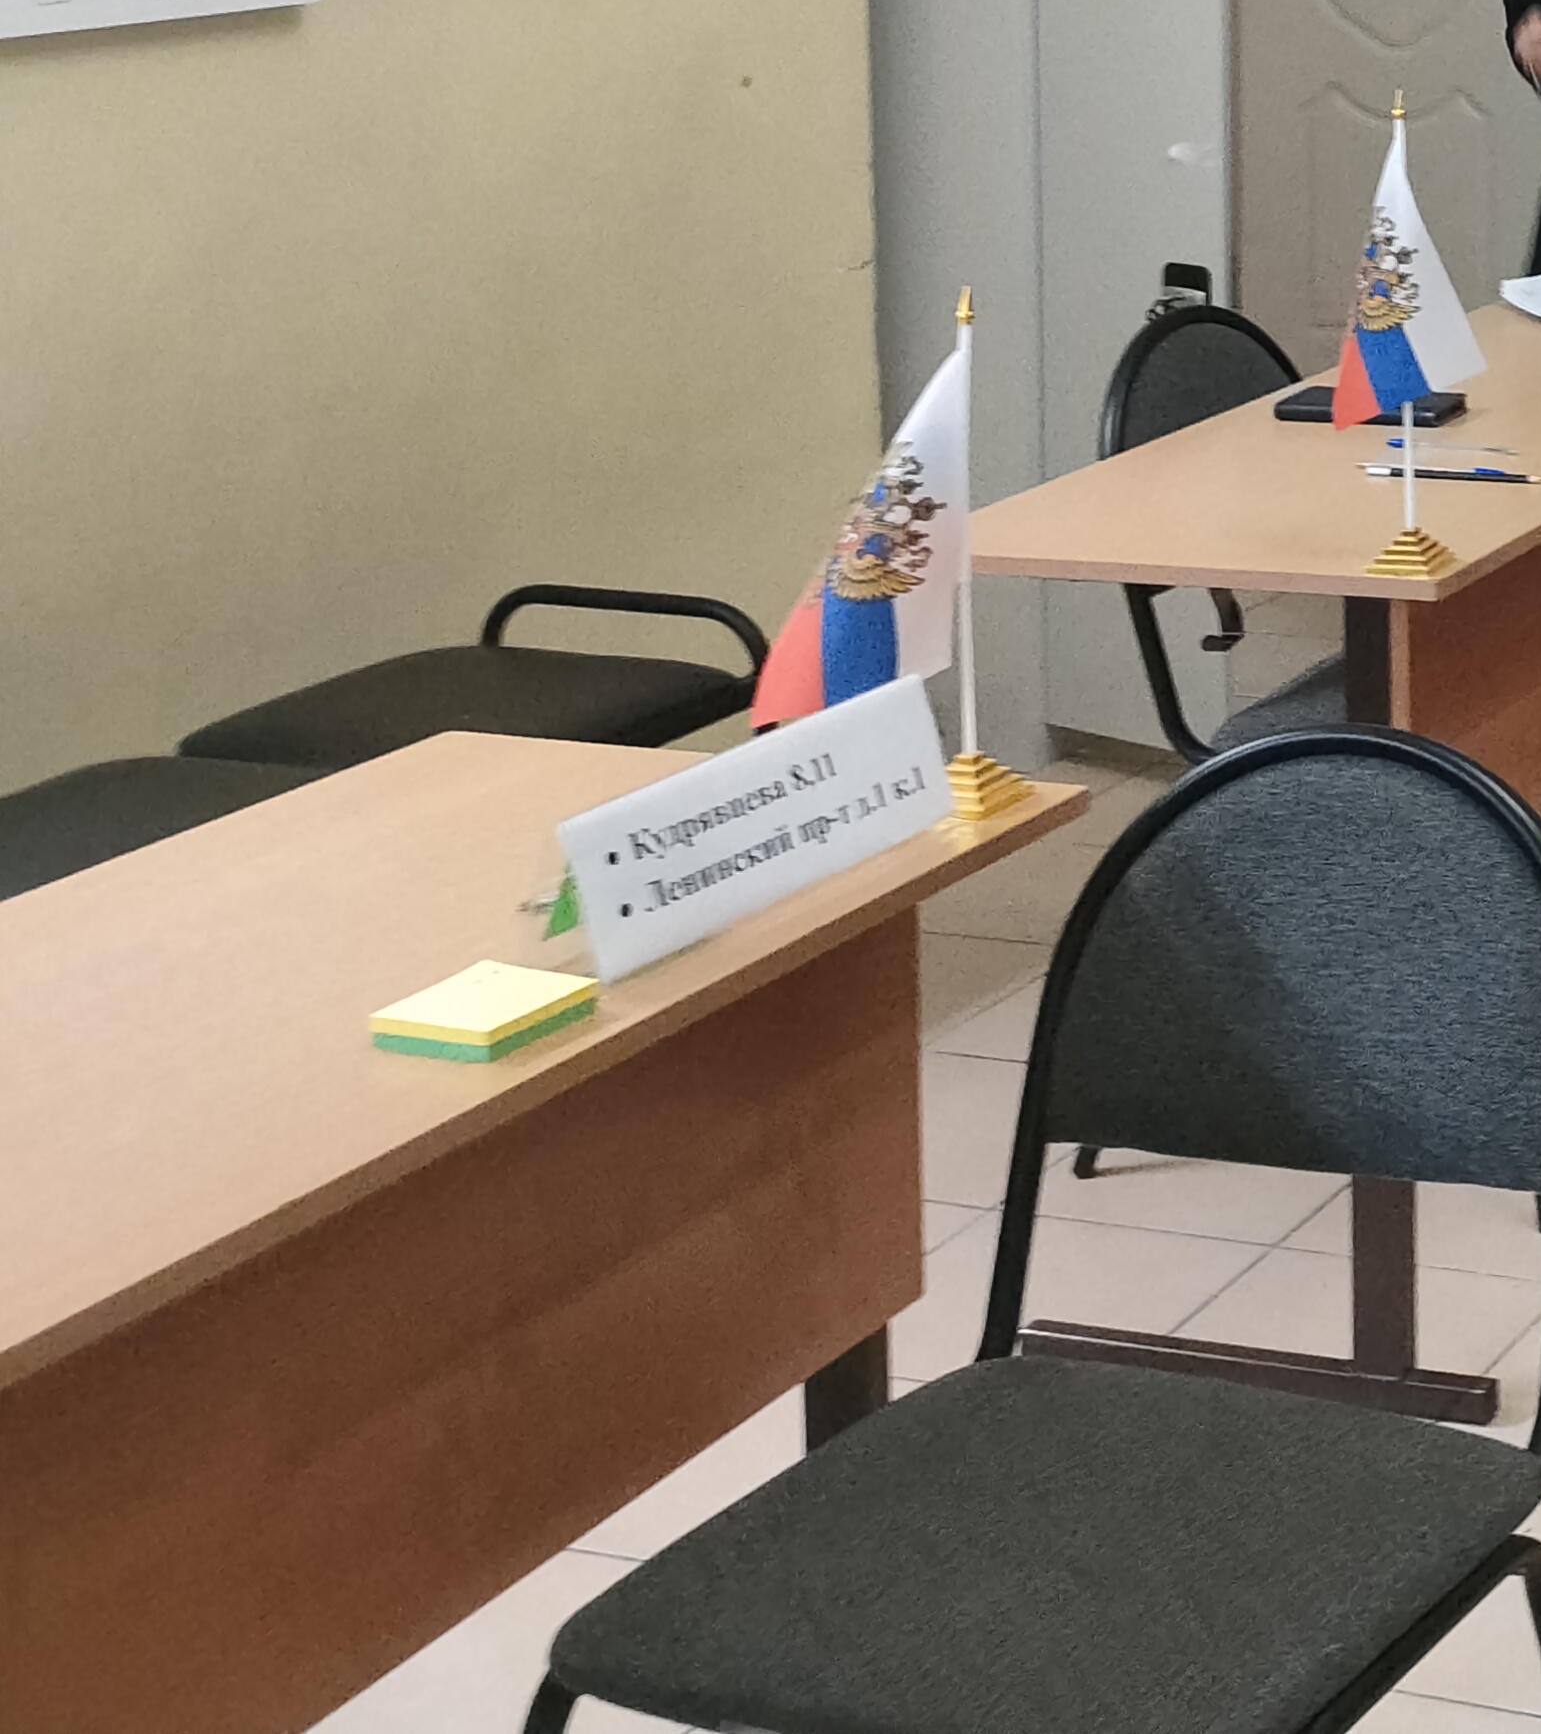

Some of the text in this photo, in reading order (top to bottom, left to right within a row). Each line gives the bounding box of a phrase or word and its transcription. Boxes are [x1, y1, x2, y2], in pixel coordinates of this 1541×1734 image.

[627, 780, 789, 860] Кудрявцева
[643, 825, 796, 912] Ленинский
[798, 804, 852, 844] пр-т
